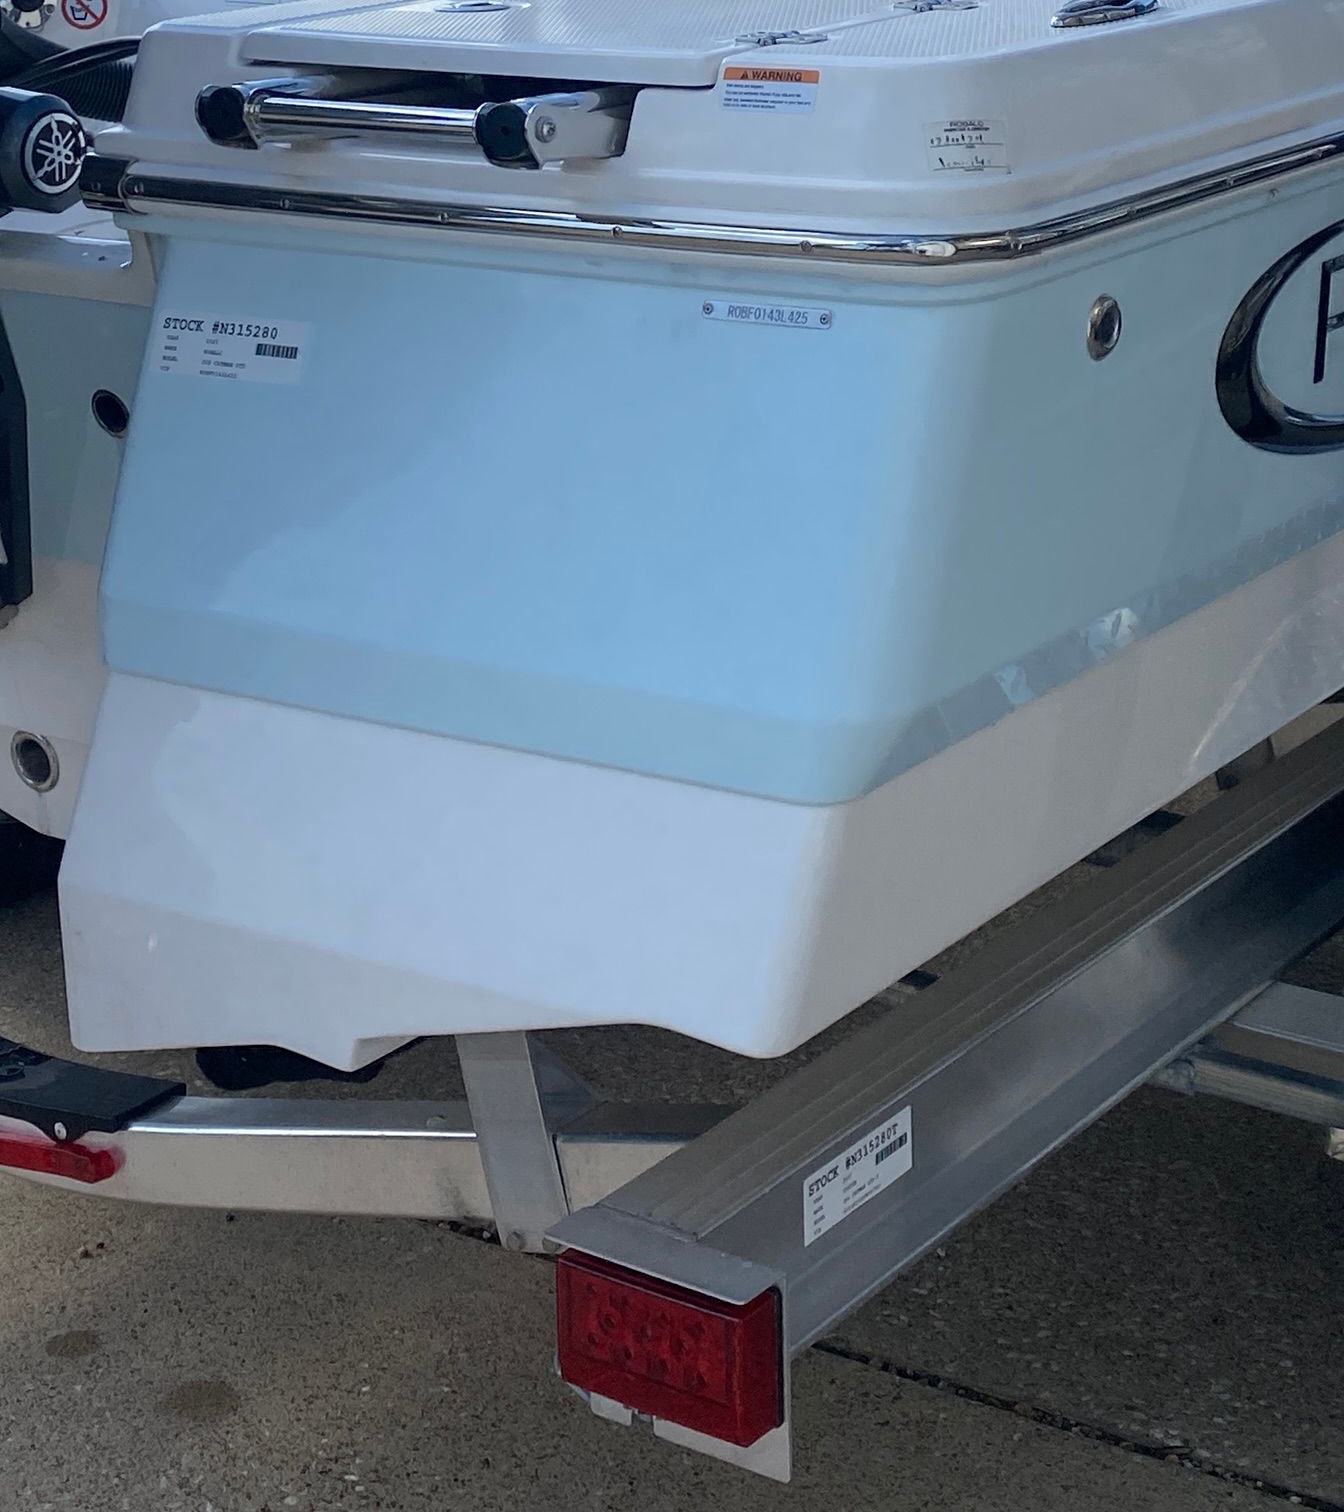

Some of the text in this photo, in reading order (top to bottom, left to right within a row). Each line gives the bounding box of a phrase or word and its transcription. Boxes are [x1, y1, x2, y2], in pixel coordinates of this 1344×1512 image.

[751, 70, 803, 82] WARNING
[162, 317, 278, 340] STOCK #N315280
[808, 1165, 839, 1197] STOCK
